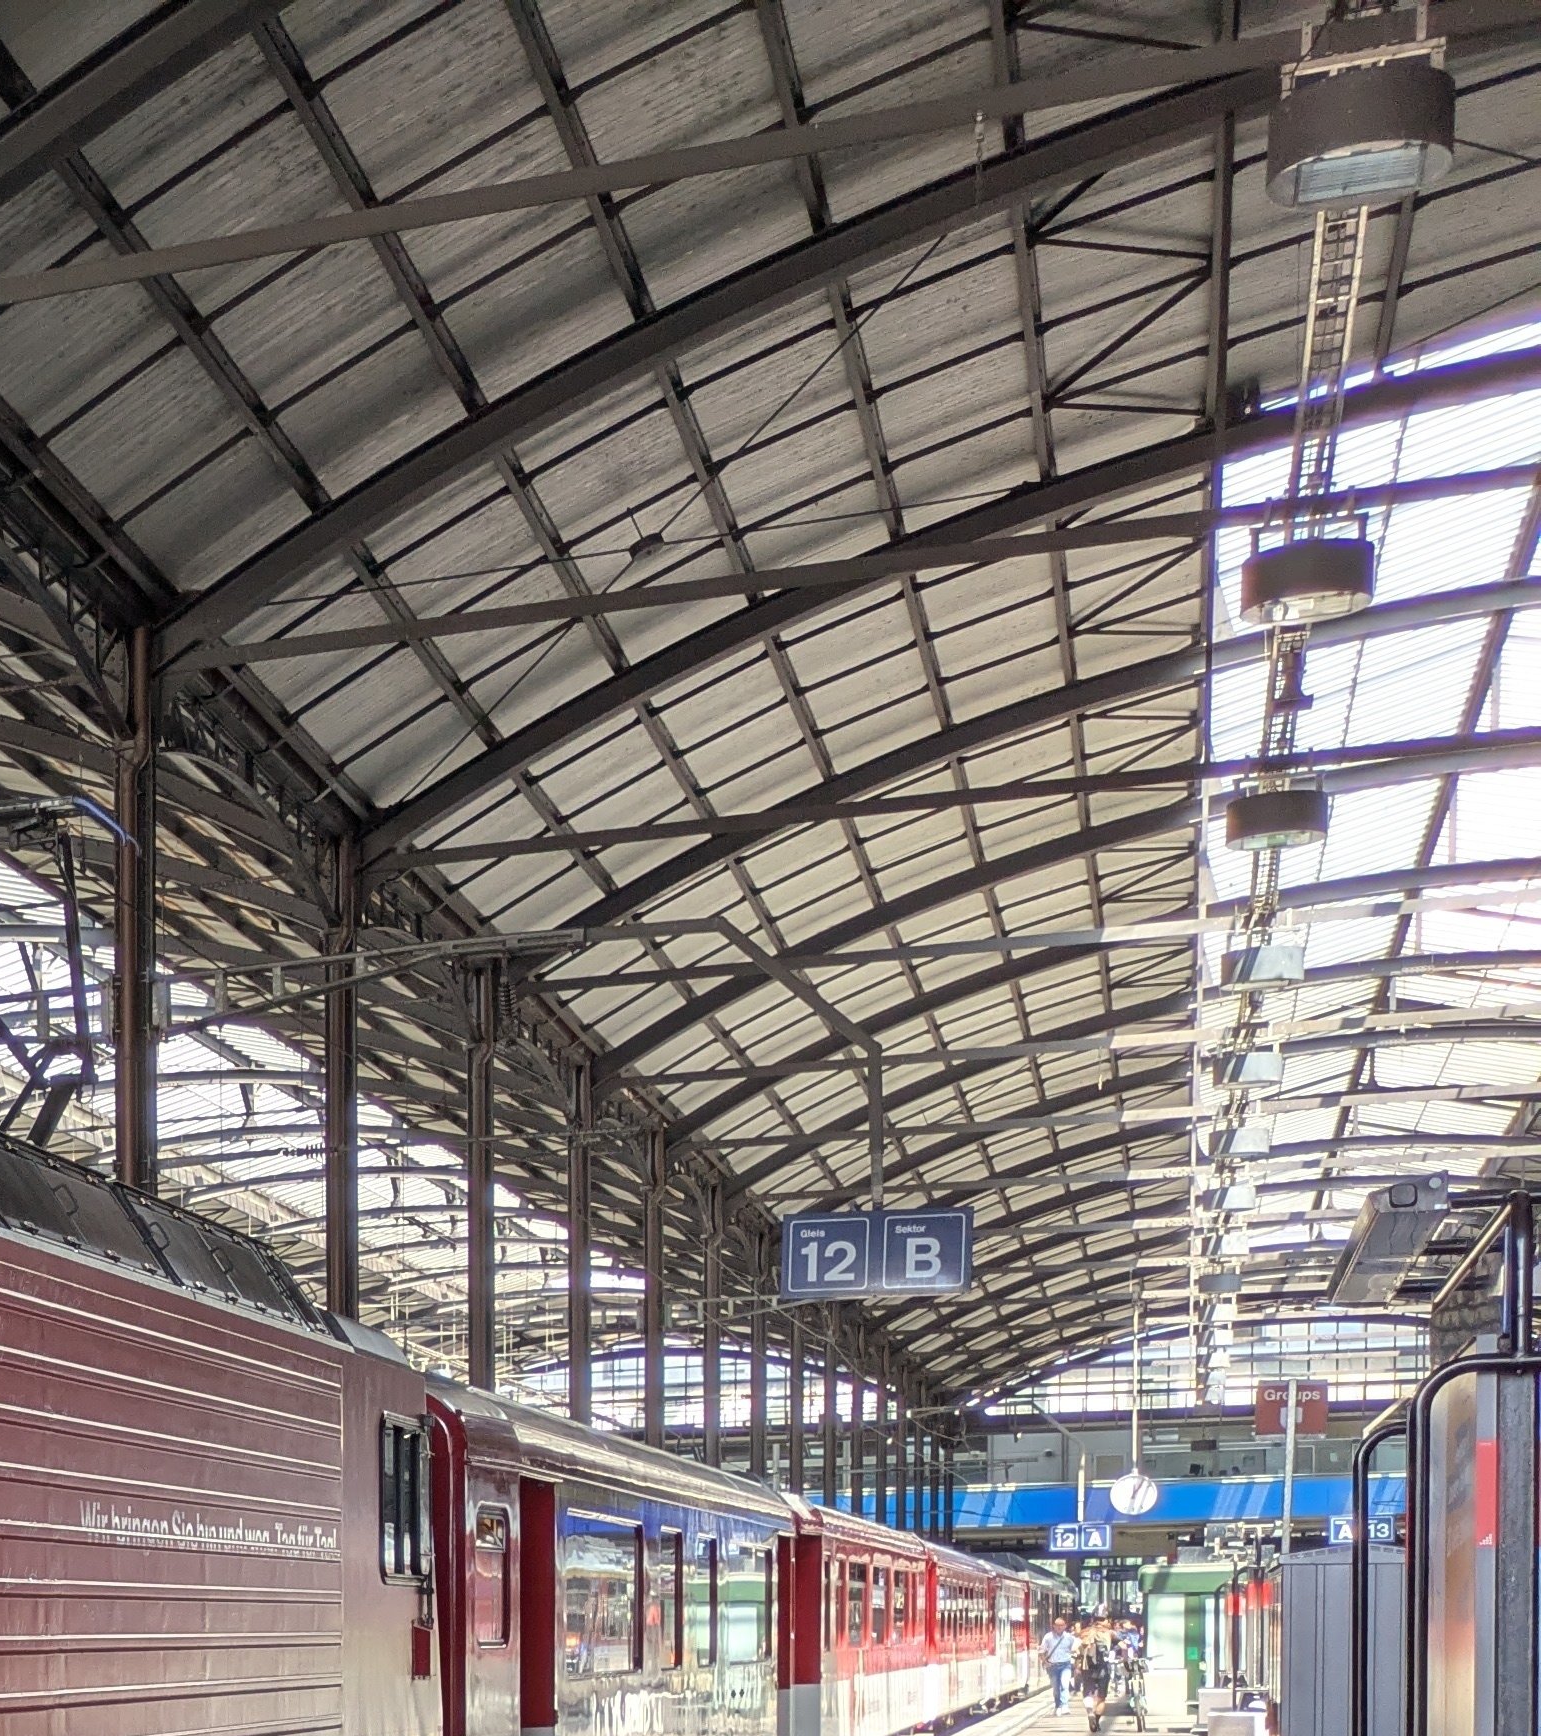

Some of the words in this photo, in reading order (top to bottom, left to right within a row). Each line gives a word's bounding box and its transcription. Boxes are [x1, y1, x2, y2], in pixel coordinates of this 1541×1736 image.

[800, 1228, 826, 1238] Gleis
[895, 1224, 927, 1234] Sektor
[800, 1240, 857, 1282] 12
[905, 1237, 942, 1279] B
[1054, 1532, 1075, 1547] 12
[1087, 1531, 1103, 1547] A
[1338, 1524, 1353, 1540] A
[1368, 1523, 1390, 1539] 13
